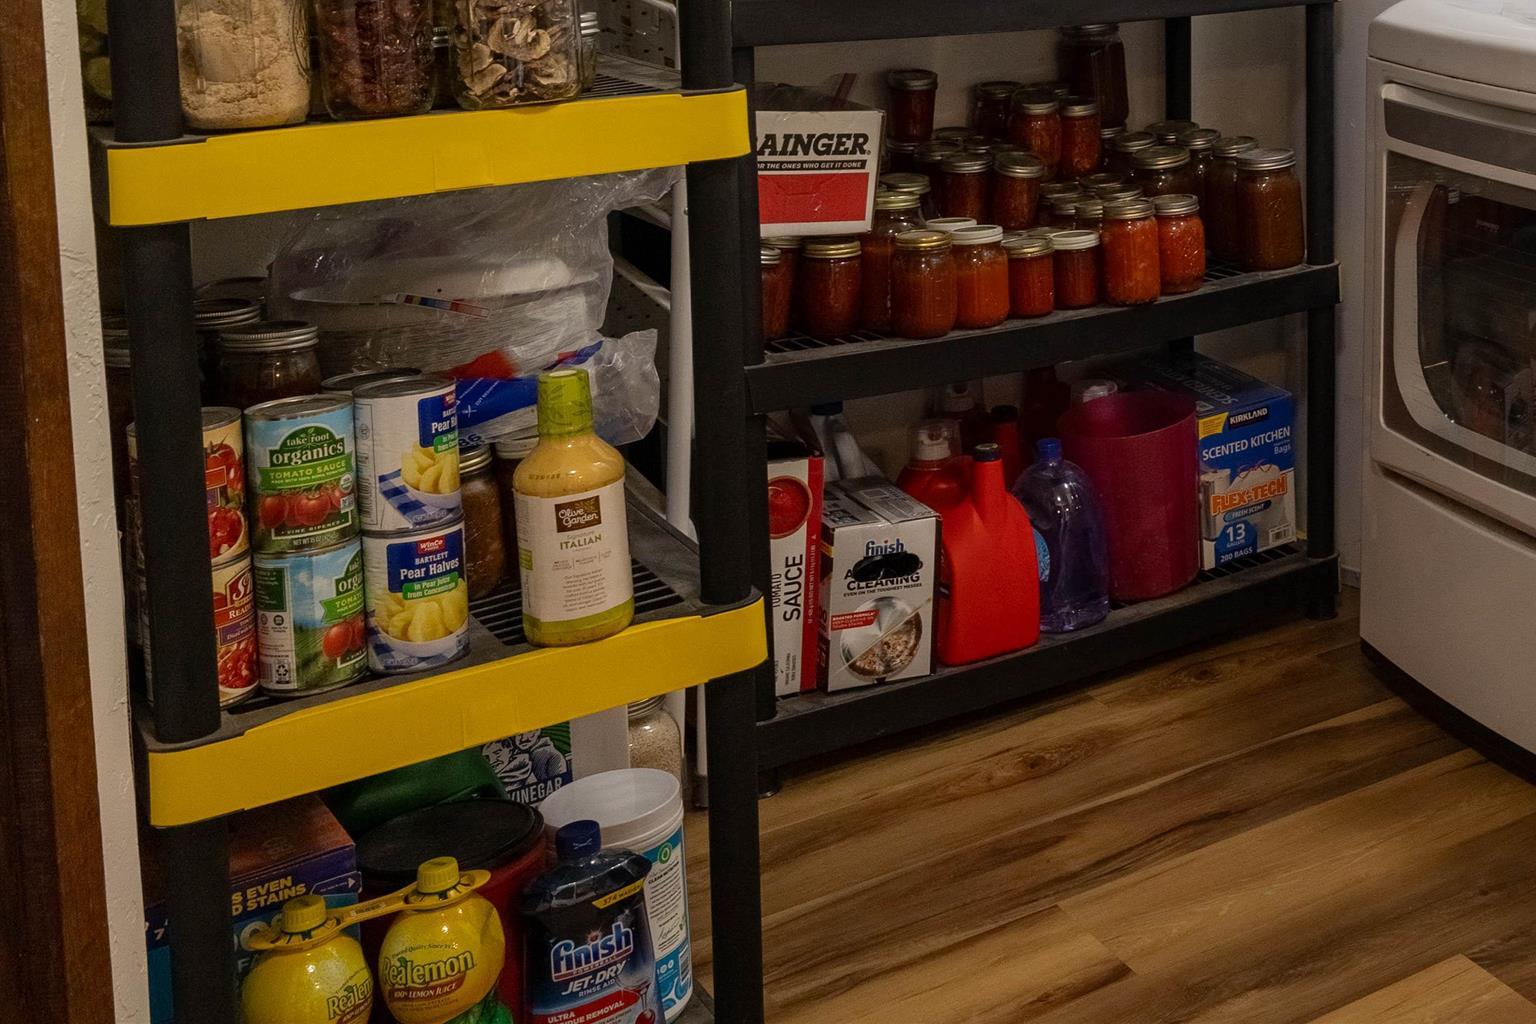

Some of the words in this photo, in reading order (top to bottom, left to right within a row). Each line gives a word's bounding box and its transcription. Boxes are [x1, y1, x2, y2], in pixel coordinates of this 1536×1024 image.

[757, 132, 869, 156] AINGER
[1229, 407, 1268, 425] KIRKLAND
[432, 419, 449, 434] Pear
[286, 437, 307, 447] take
[310, 432, 330, 444] root
[1202, 441, 1249, 461] SCENTED
[1250, 425, 1291, 448] KITCHEN
[271, 440, 344, 466] organics
[1273, 444, 1291, 456] Bags
[270, 467, 313, 479] TOMATO
[316, 460, 347, 475] SAUCE
[558, 507, 584, 519] Olive
[562, 511, 599, 527] Garden
[560, 534, 602, 550] ITALIAN
[1226, 523, 1246, 542] 13
[865, 538, 905, 556] finish
[1220, 551, 1233, 563] 200
[1234, 547, 1253, 559] BAGS
[415, 551, 448, 565] BARTLETT
[400, 563, 426, 580] Pear
[429, 558, 460, 576] Halves
[783, 554, 804, 622] SAUCE
[246, 883, 306, 911] STAINS
[247, 876, 292, 899] EVEN
[552, 922, 633, 976] finish
[384, 950, 475, 988] ReaLemon
[561, 959, 627, 995] JET-DRY
[408, 988, 434, 999] LEMON
[578, 985, 602, 997] RINSE
[602, 978, 616, 989] AID
[547, 1010, 575, 1023] ULTRA
[586, 1000, 625, 1023] REMOVAL
